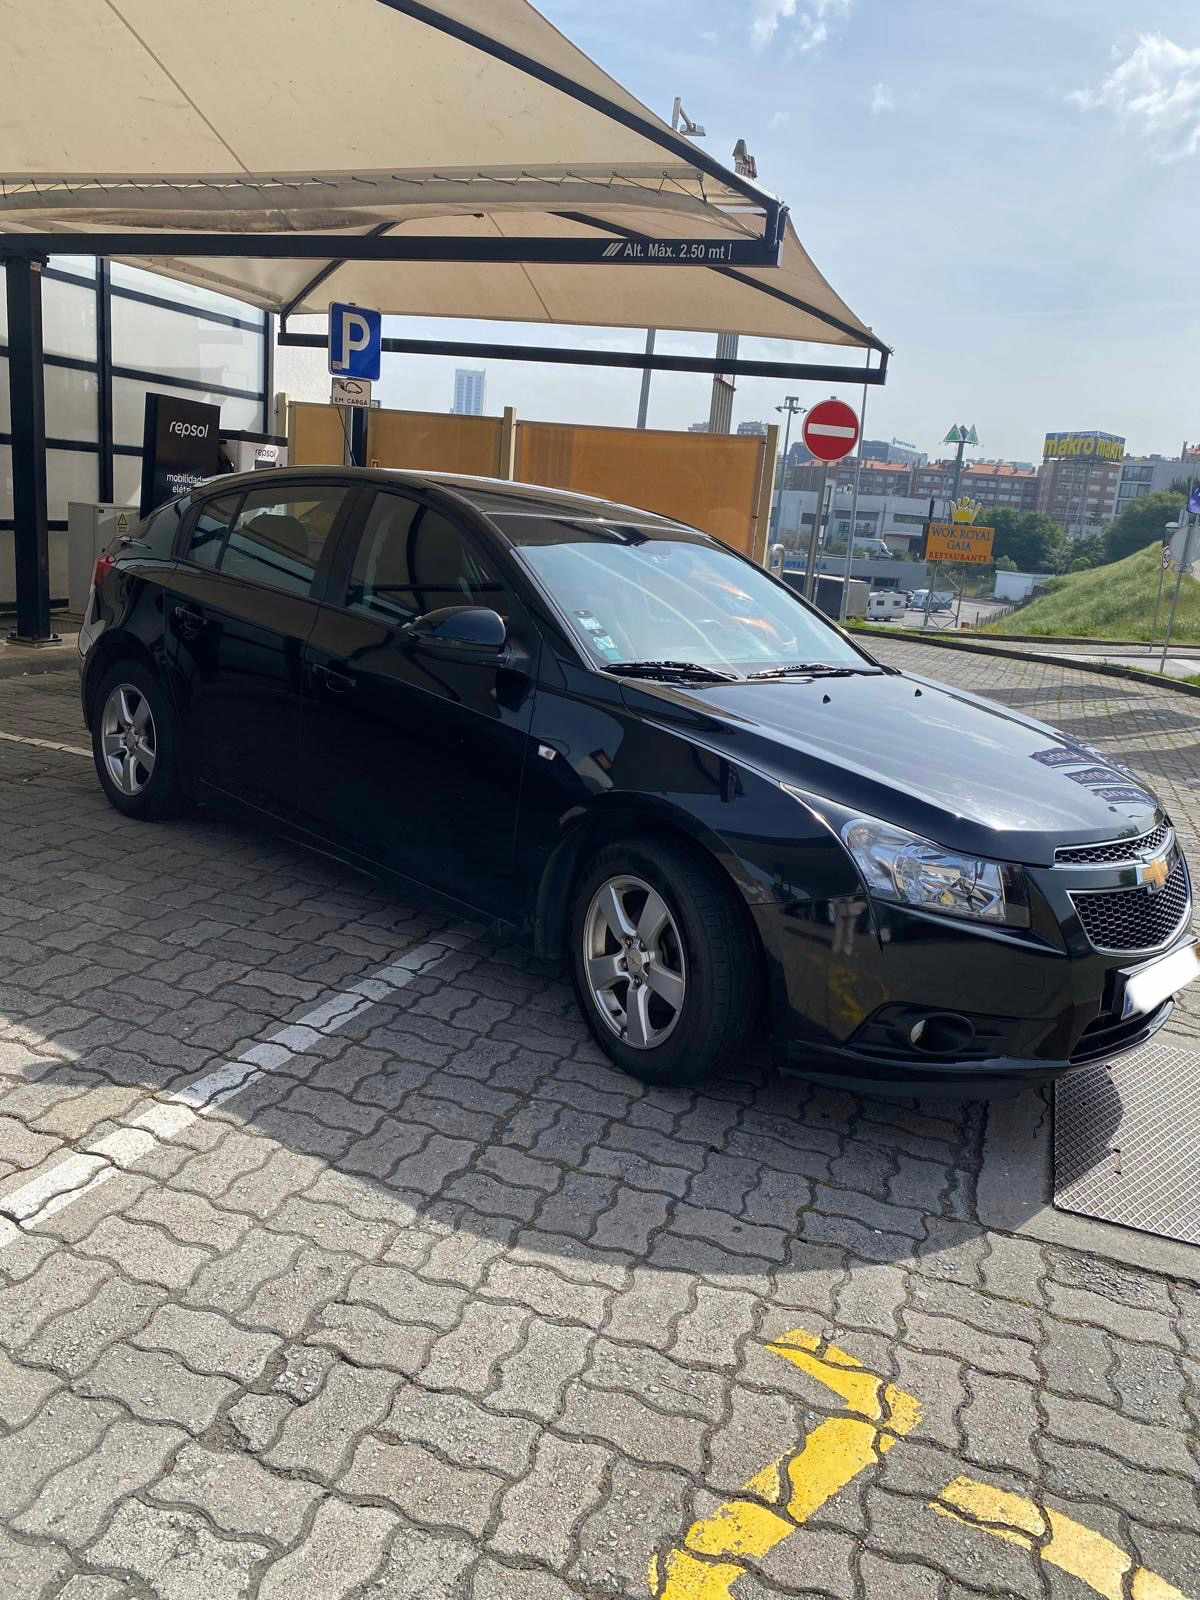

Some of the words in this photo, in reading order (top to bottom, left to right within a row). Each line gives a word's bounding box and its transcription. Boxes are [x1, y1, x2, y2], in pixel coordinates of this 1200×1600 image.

[624, 243, 644, 257] Alt.
[648, 243, 676, 258] Máx.
[679, 244, 705, 259] 2.50
[708, 247, 725, 259] mt
[342, 311, 371, 369] P
[346, 398, 368, 406] CARGA
[169, 421, 209, 438] repsol
[1044, 435, 1096, 456] makro
[255, 449, 275, 458] repsol
[166, 473, 204, 484] mobilidad
[172, 484, 192, 493] elétr
[931, 527, 957, 538] WOK
